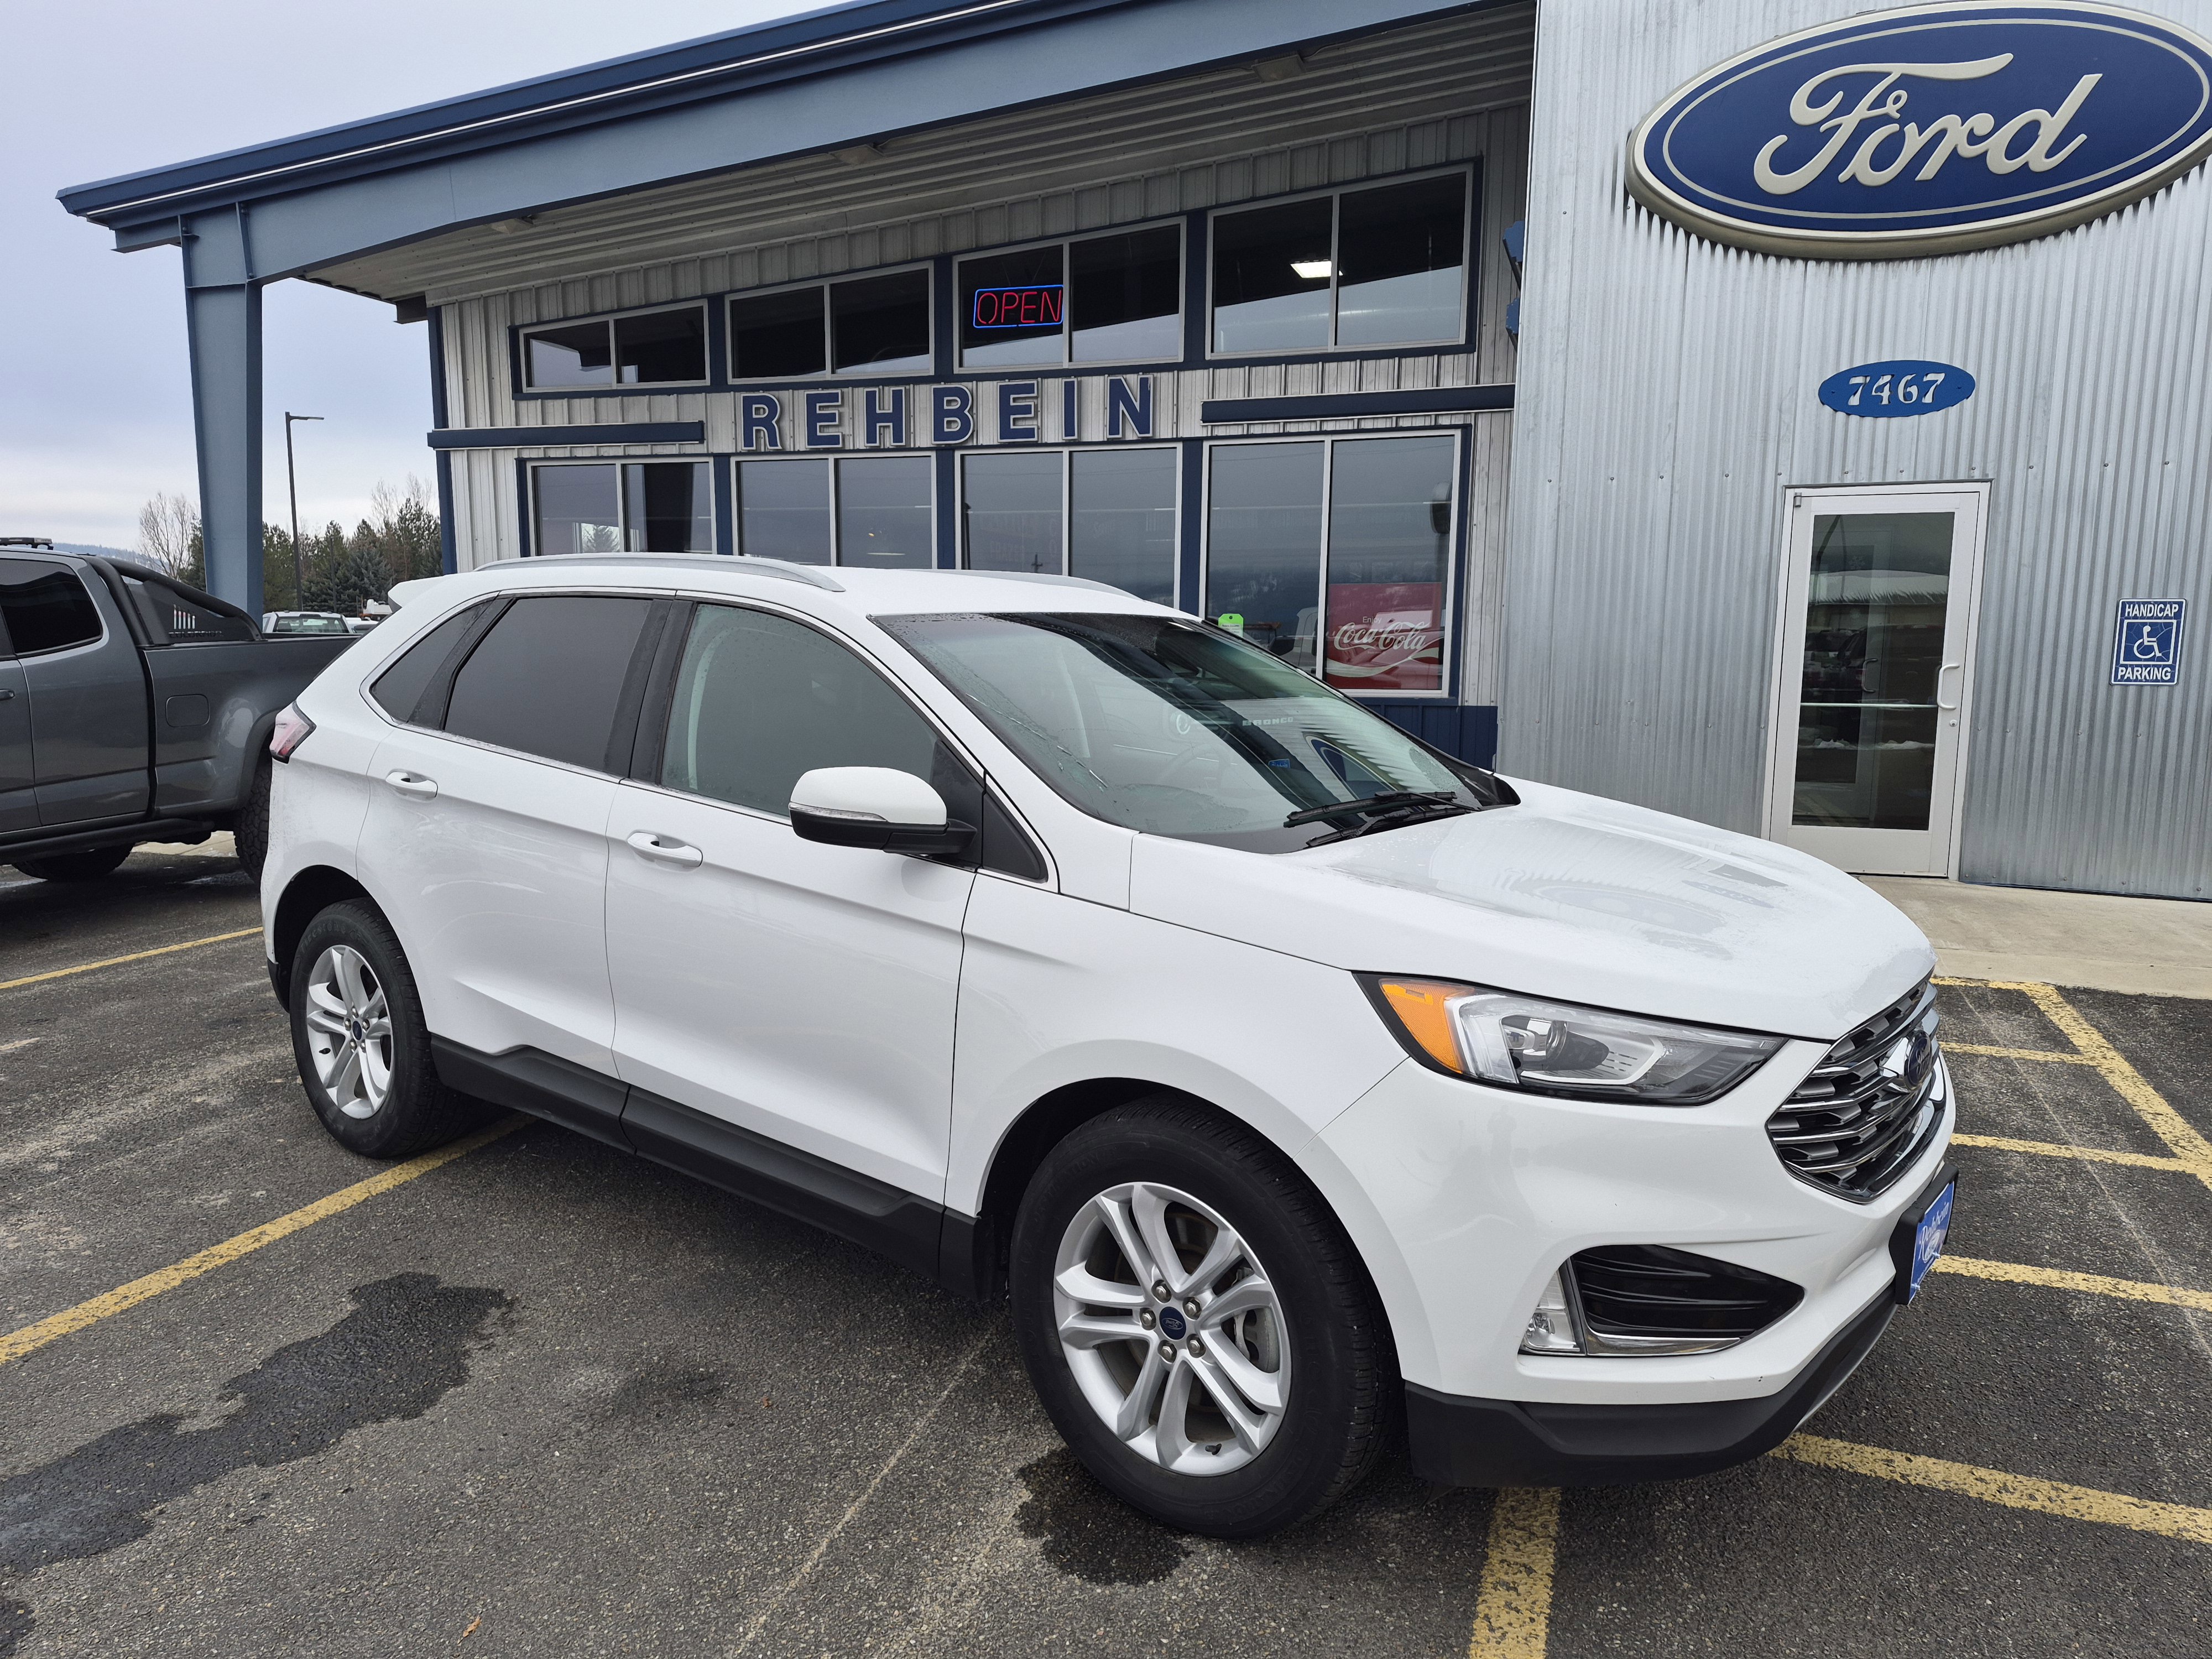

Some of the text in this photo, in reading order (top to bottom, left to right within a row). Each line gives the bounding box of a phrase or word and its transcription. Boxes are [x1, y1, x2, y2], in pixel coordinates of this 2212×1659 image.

[1754, 53, 2103, 195] Ford
[977, 289, 1062, 324] OPEN
[1848, 372, 1945, 406] 7467
[740, 374, 1154, 450] REHBEIN
[1362, 616, 1383, 624] Enjoy
[2125, 603, 2179, 617] HANDICAP
[1333, 621, 1431, 651] Coca-Cola
[2117, 666, 2172, 681] PARKING
[1242, 717, 1294, 726] BRONCO
[1918, 1201, 1950, 1261] Rehbein
